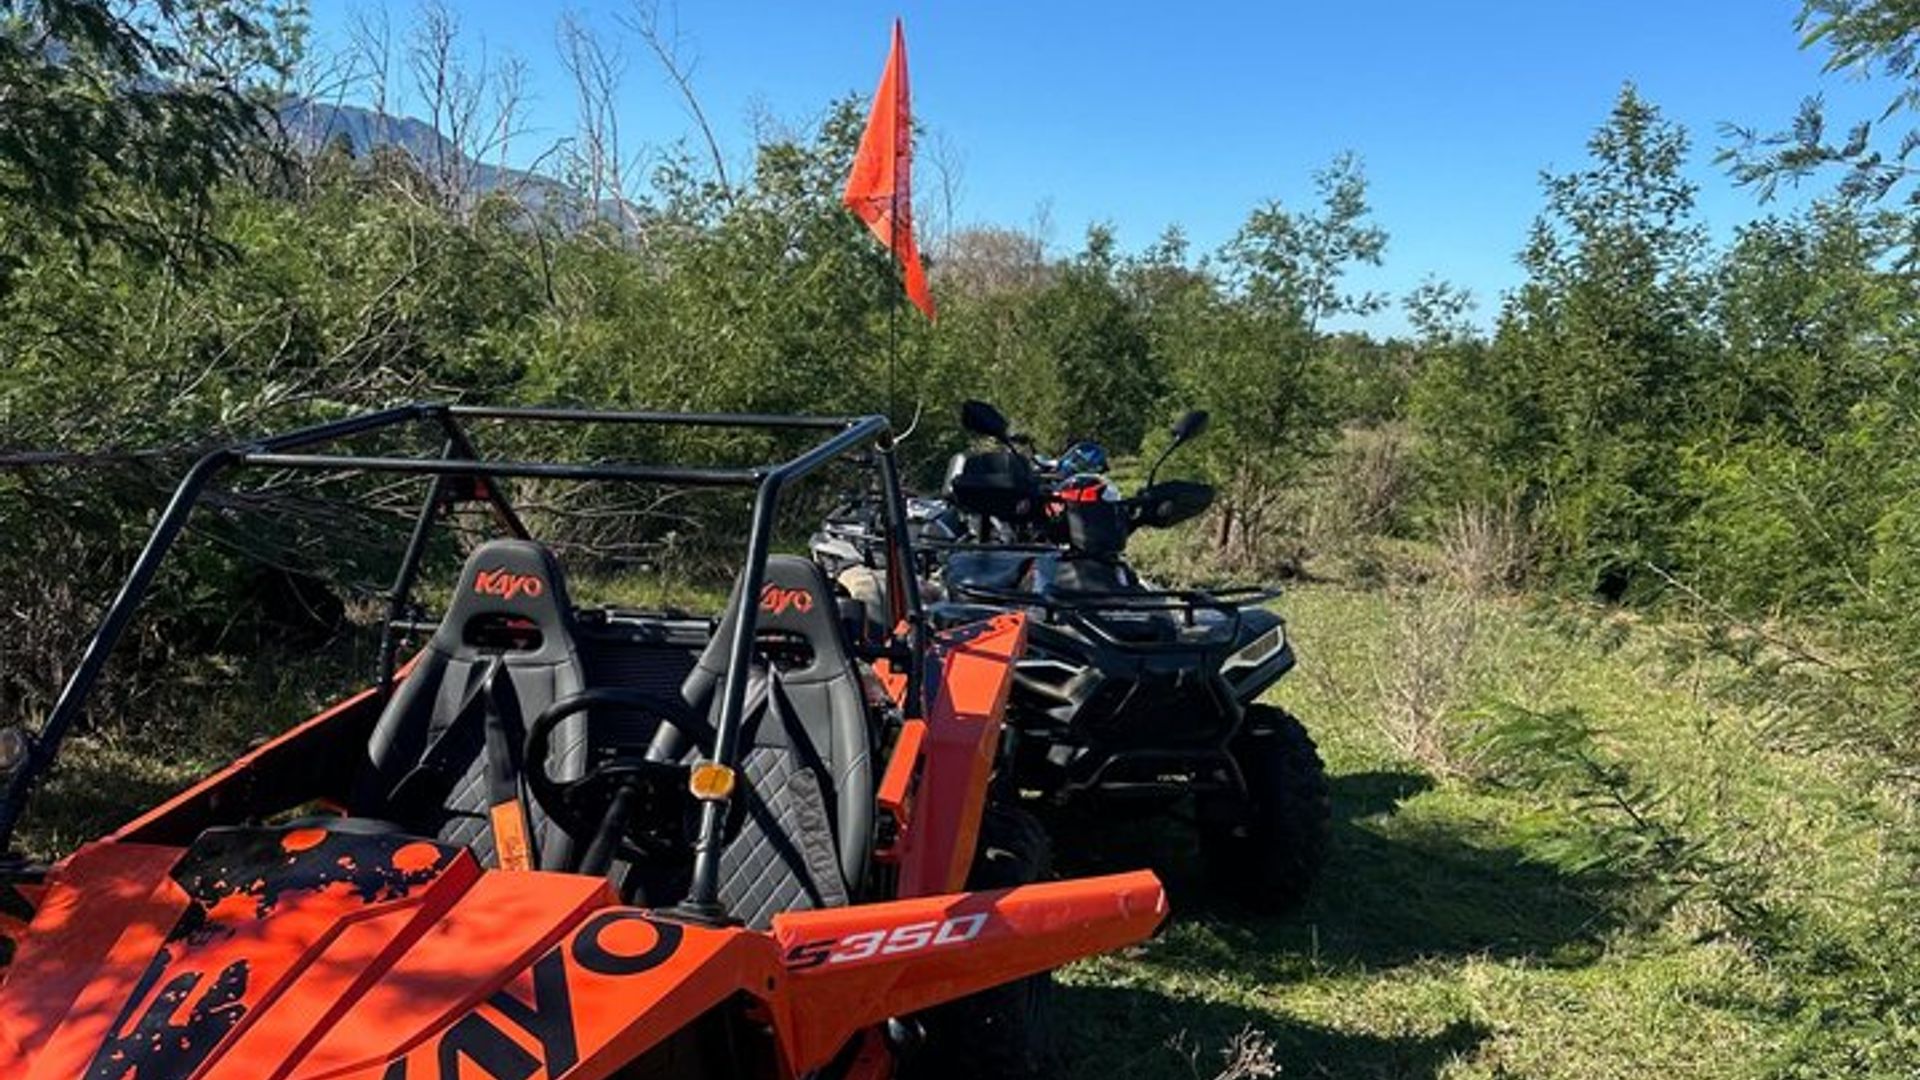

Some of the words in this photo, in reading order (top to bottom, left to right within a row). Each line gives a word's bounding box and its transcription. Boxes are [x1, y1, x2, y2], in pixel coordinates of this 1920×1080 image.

[474, 566, 544, 600] KAYO
[786, 912, 989, 971] S350
[382, 911, 683, 1080] AYO
